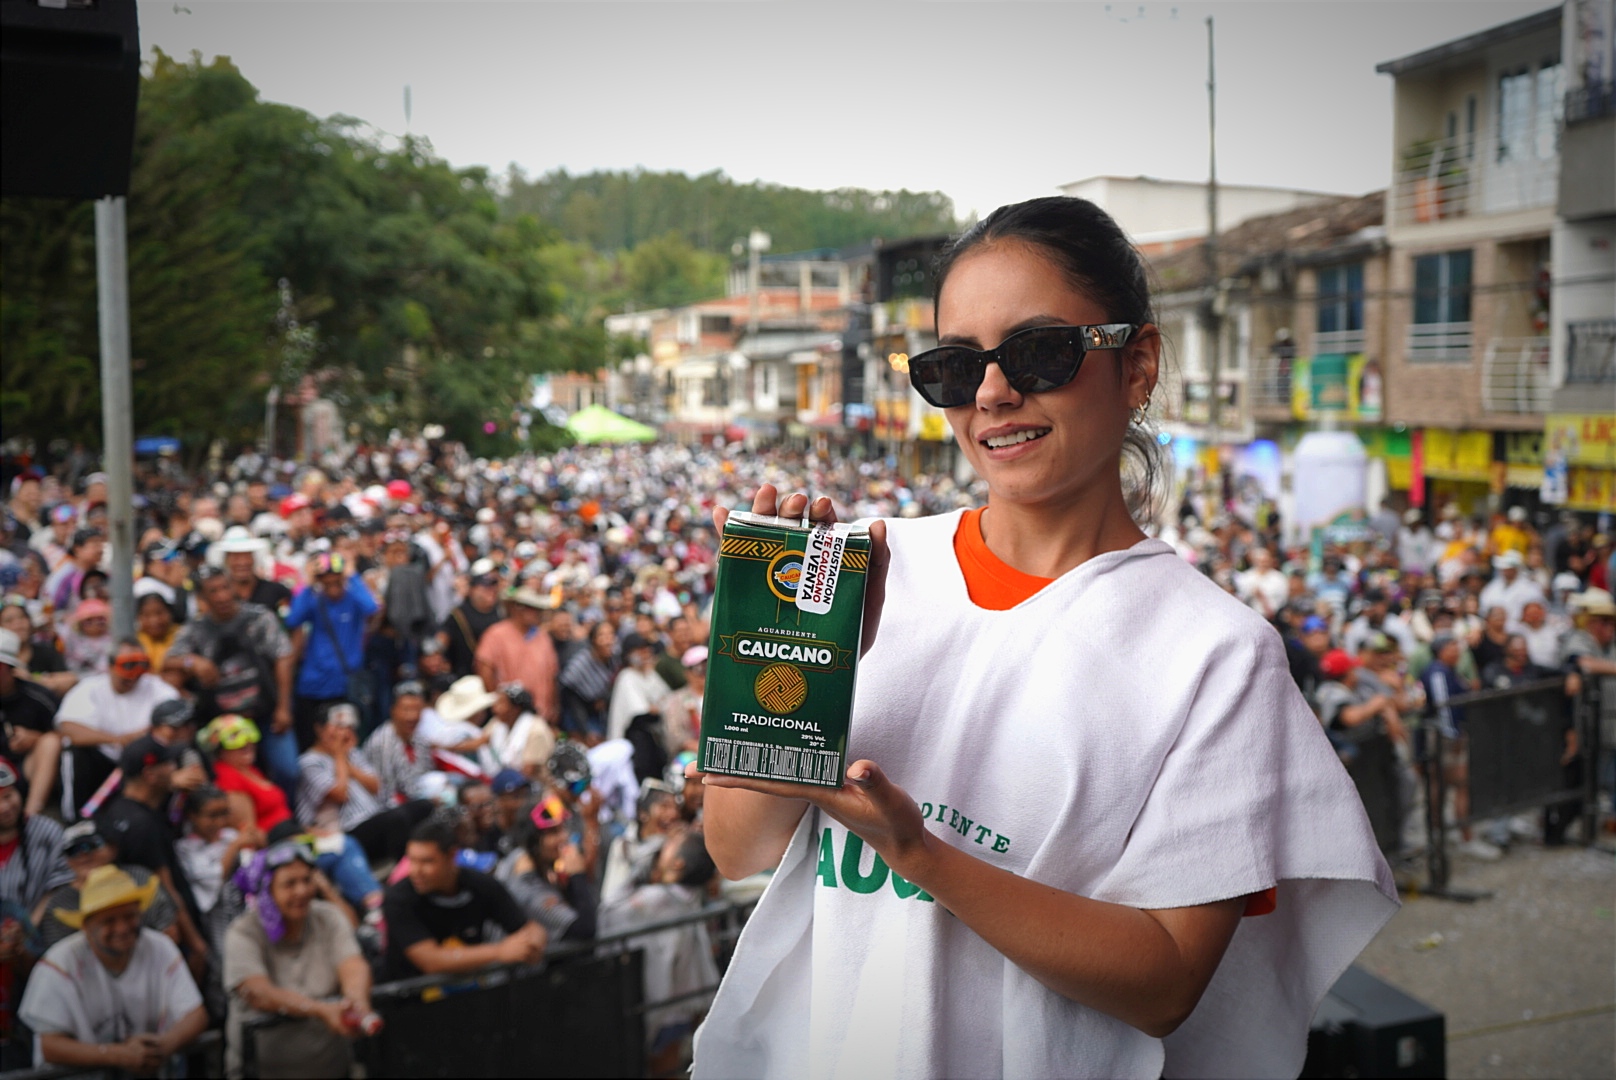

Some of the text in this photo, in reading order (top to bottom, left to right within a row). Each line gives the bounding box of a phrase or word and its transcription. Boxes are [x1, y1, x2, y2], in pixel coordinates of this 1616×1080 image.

[823, 534, 833, 549] TE
[802, 555, 820, 600] VENTA
[813, 551, 830, 603] CAUCANO
[823, 537, 843, 604] EGUSTACIÓN
[758, 627, 817, 638] AGUARDIENTE
[738, 640, 832, 664] CAUCANO
[732, 713, 821, 732] TRADICIONAL
[919, 802, 1011, 853] DIENTE
